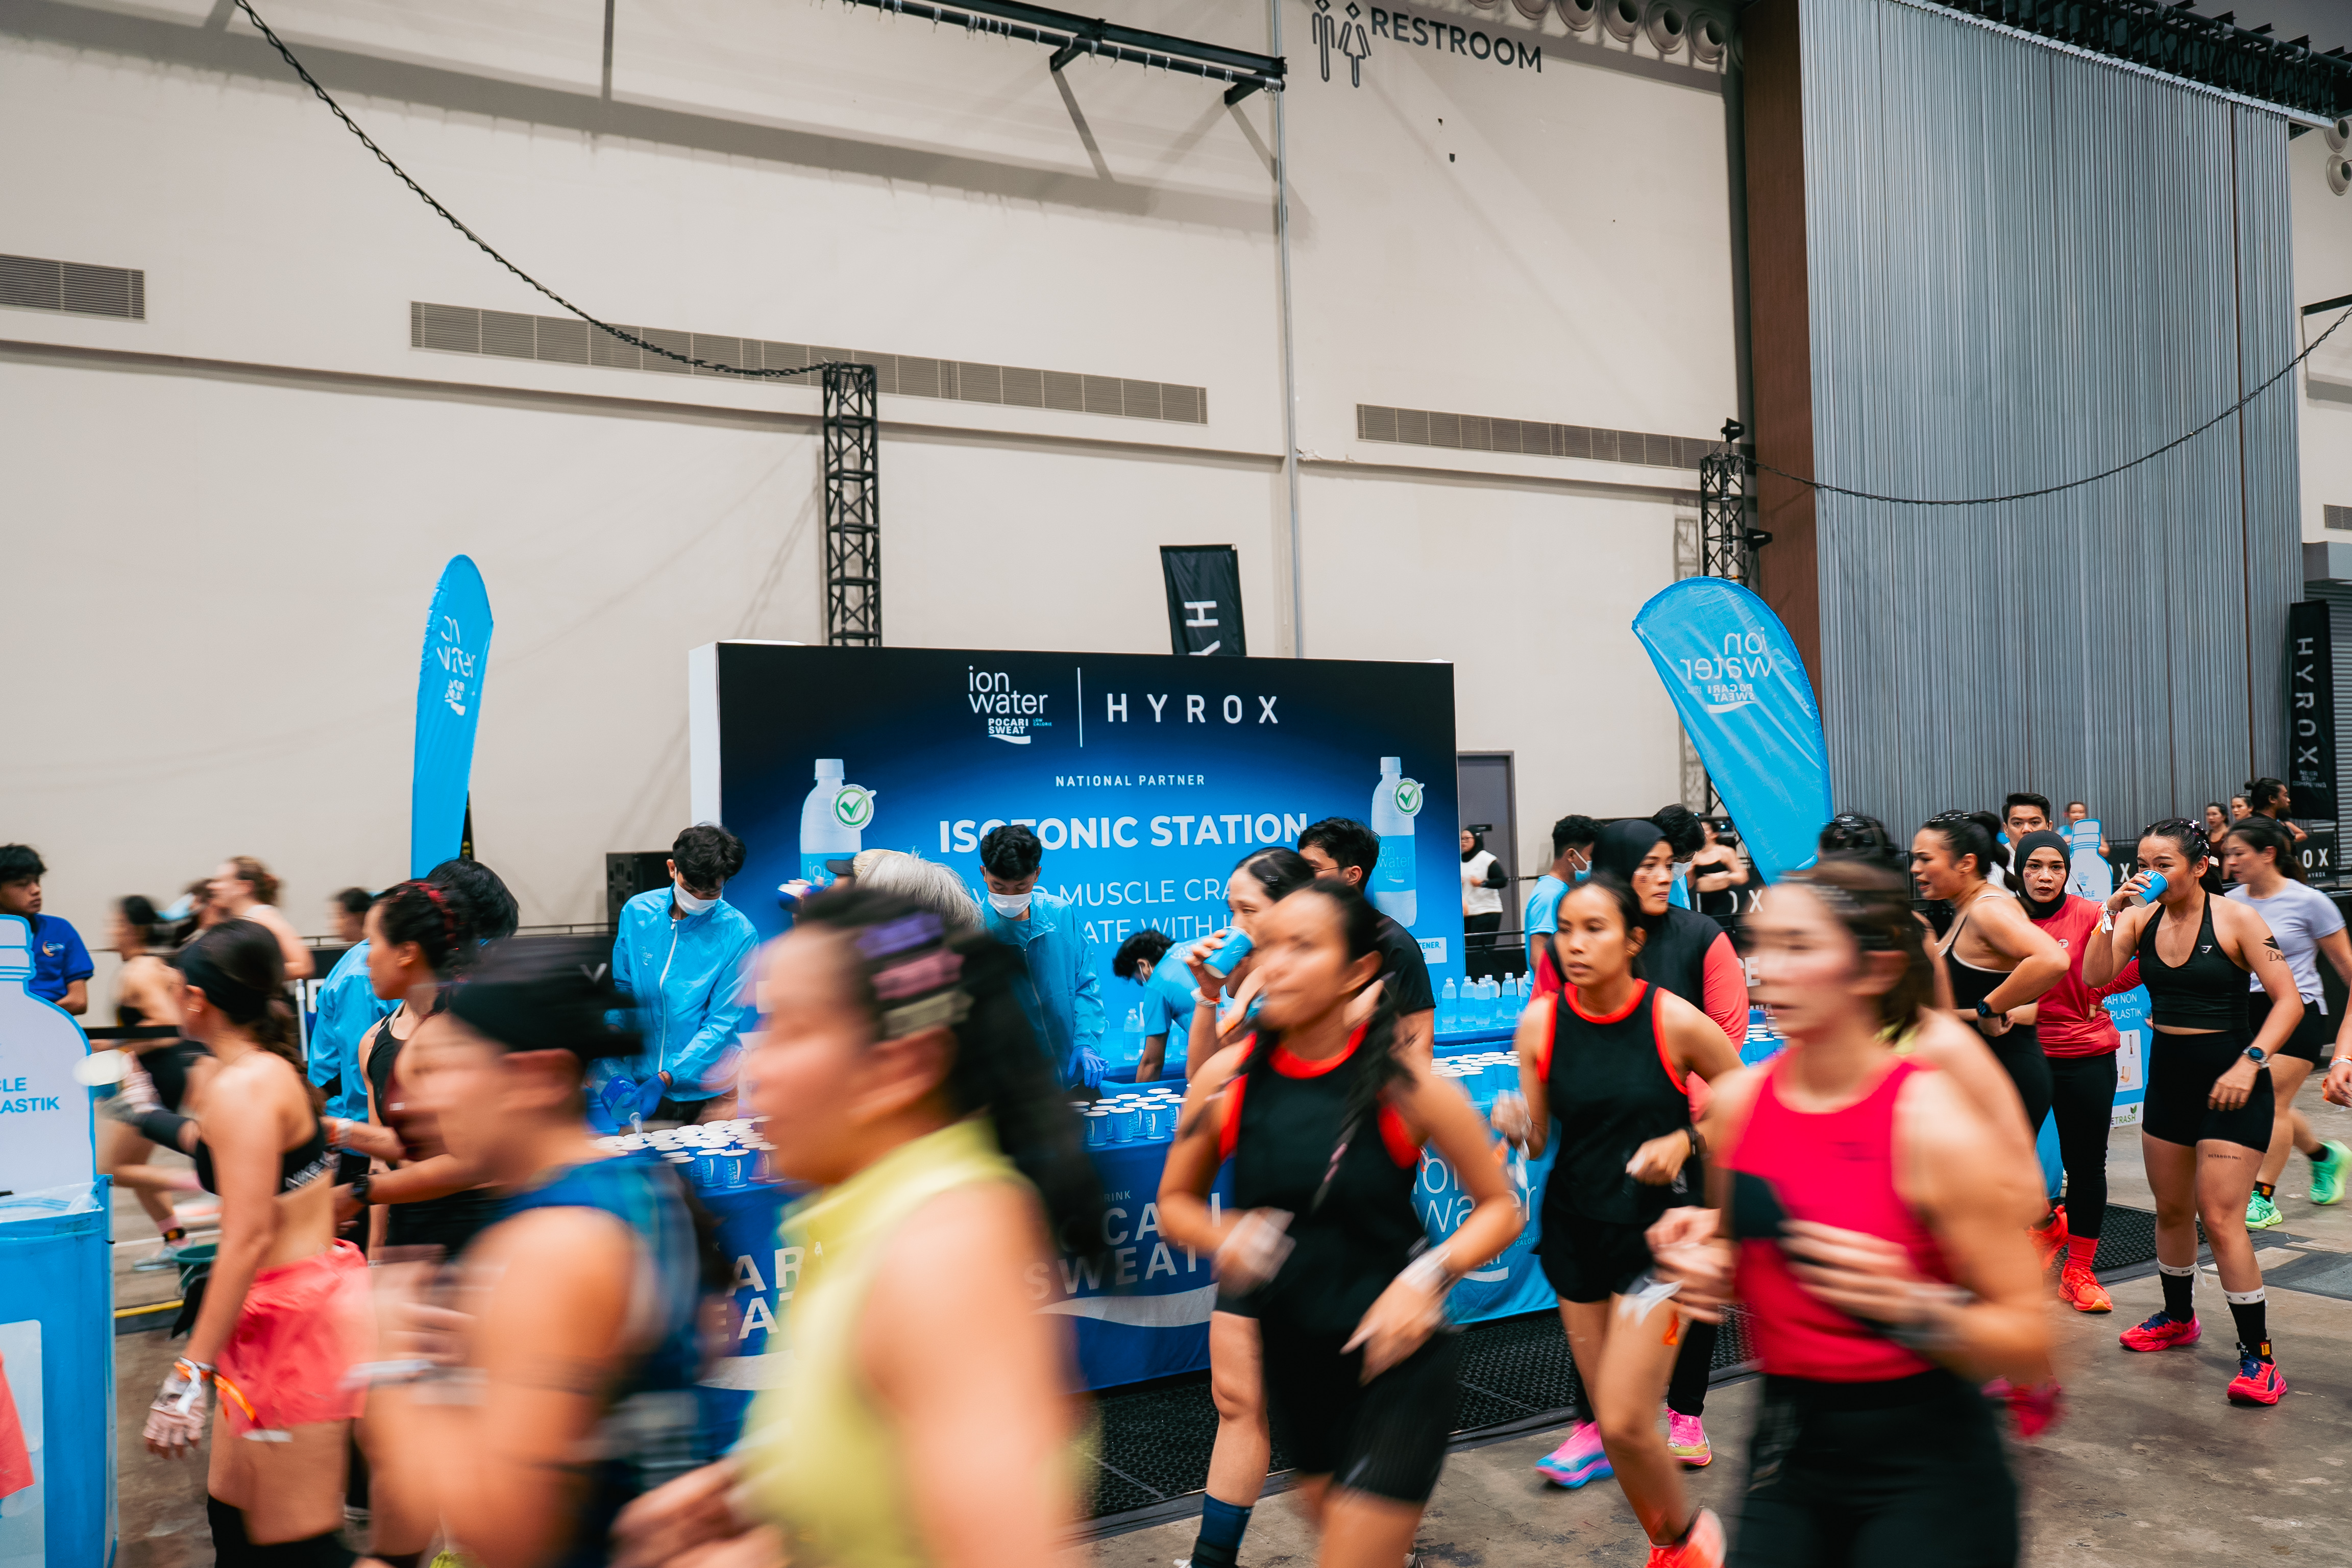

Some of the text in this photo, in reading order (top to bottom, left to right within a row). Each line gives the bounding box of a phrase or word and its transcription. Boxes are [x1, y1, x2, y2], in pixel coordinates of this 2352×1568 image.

[1371, 6, 1541, 73] RESTROOM
[969, 665, 1009, 692] ion
[968, 690, 1048, 714] water
[2295, 637, 2318, 764] HYROX
[1107, 693, 1278, 724] HYROX
[988, 718, 1028, 726] POCARI
[988, 726, 1025, 734] SWEAT
[1056, 774, 1205, 787] NATIONAL PARTNER
[1150, 813, 1307, 847] STATION
[1378, 855, 1410, 867] water
[1060, 880, 1175, 906] MUSCLE
[2120, 993, 2137, 1004] NON
[2111, 1007, 2142, 1019] PLASTIK
[1104, 1190, 1131, 1202] RINK
[1515, 1235, 1540, 1247] CALORIE
[1518, 1231, 1529, 1239] OW
